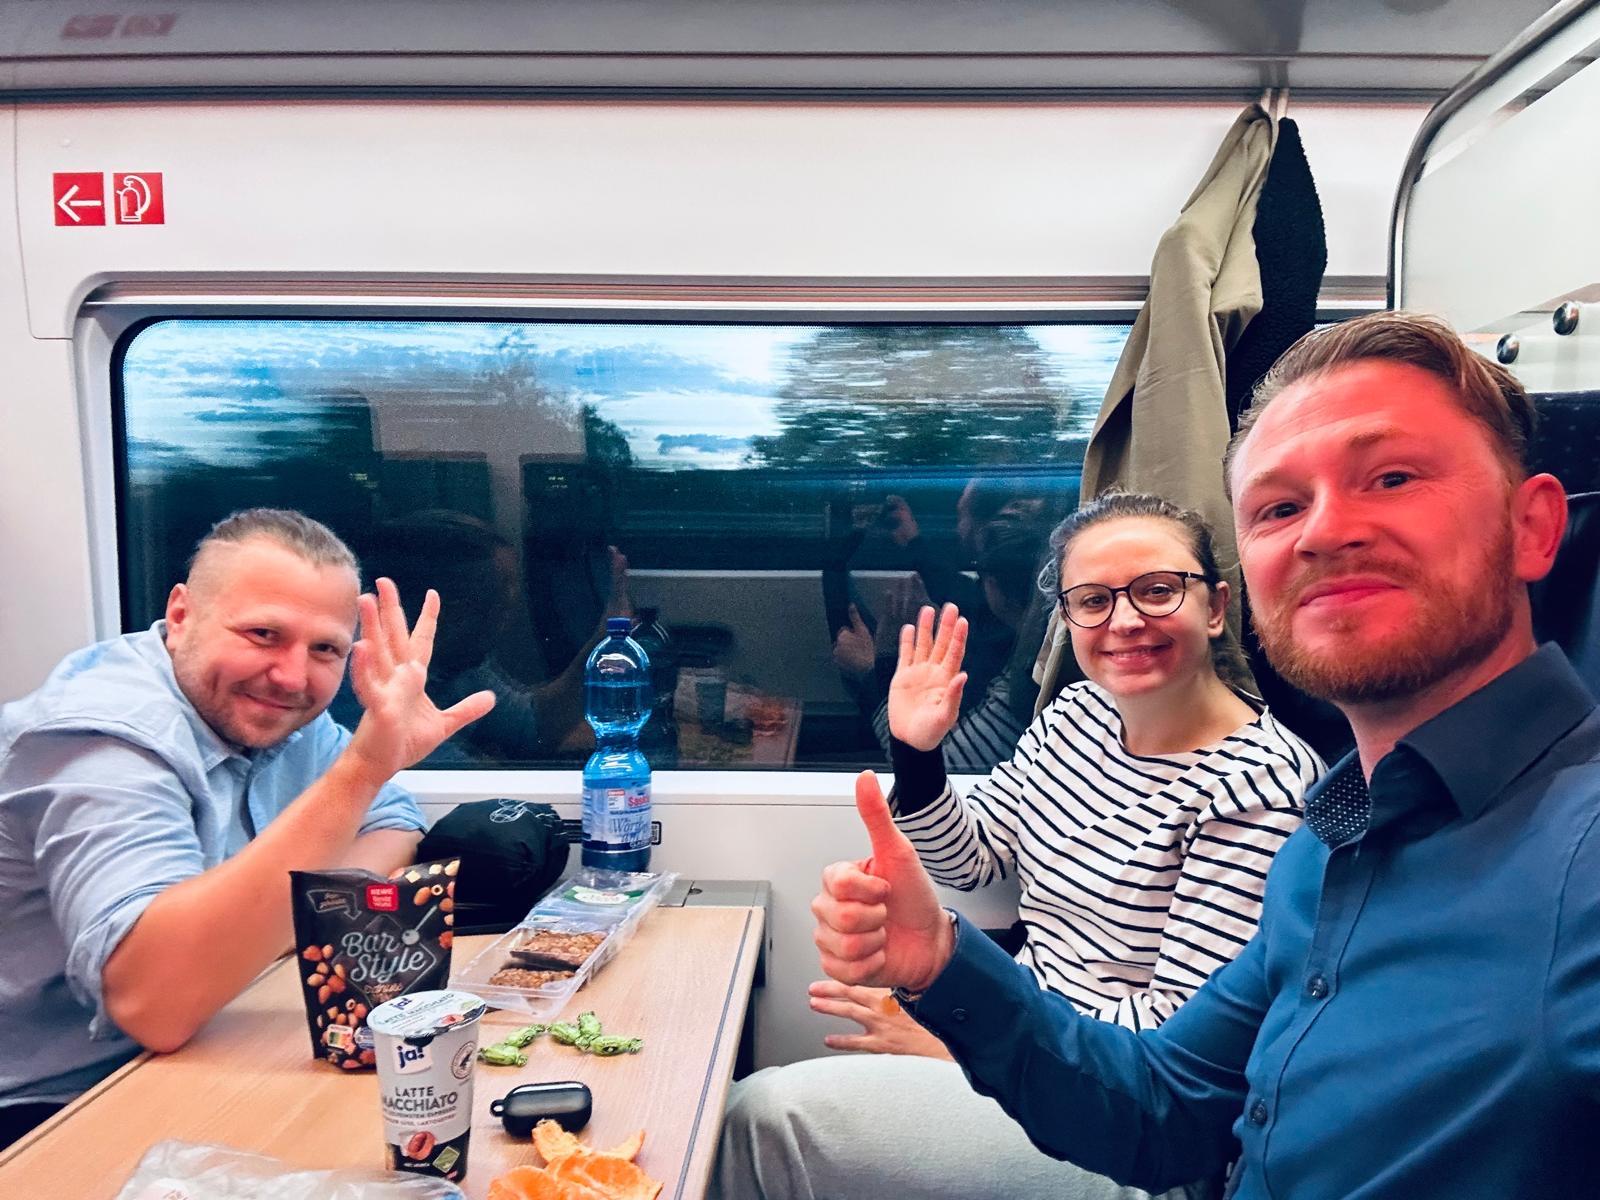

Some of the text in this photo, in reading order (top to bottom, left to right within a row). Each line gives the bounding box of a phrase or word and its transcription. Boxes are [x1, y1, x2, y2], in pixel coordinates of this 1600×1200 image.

[342, 931, 399, 957] Bar
[351, 947, 426, 983] Style
[389, 997, 413, 1011] ja!
[396, 1045, 425, 1069] ja!
[395, 1086, 434, 1097] LATTE
